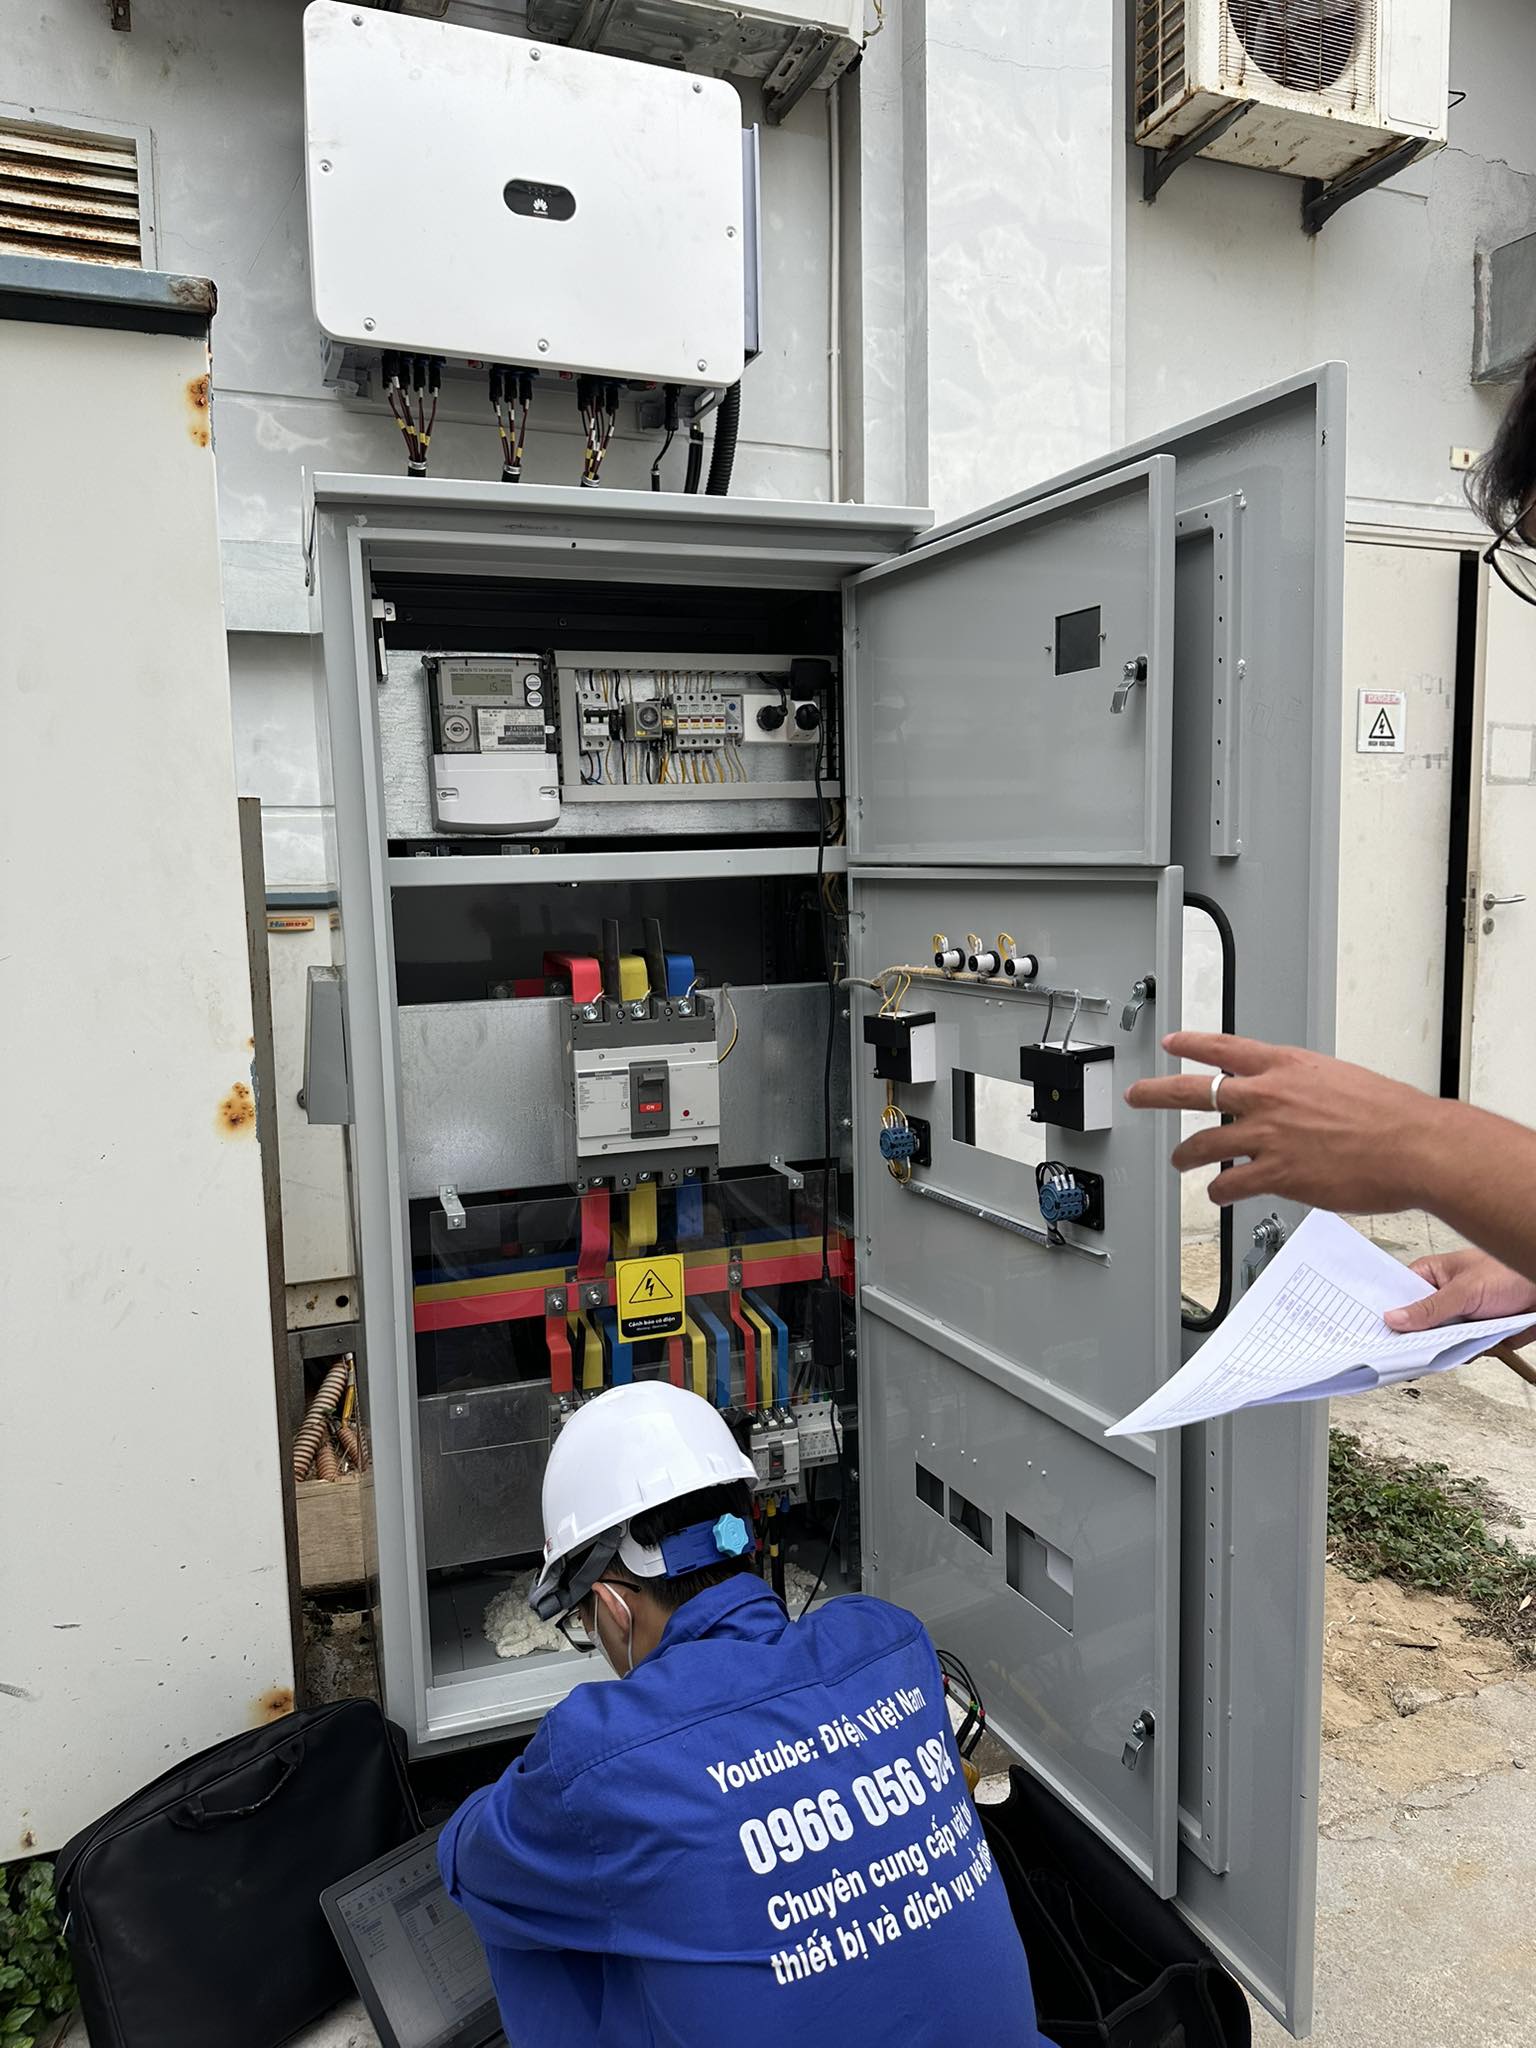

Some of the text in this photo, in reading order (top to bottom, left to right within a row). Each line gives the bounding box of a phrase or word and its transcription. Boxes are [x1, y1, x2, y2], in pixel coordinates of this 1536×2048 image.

[706, 1738, 820, 1794] Youtube:
[859, 1698, 903, 1735] Việt
[899, 1687, 926, 1715] Nam
[739, 1790, 854, 1875] 0966
[852, 1758, 927, 1827] 056
[768, 1869, 868, 1930] Chuyên
[869, 1843, 928, 1888] cung
[926, 1814, 956, 1859] cấp
[771, 1929, 838, 1985] thiết
[837, 1920, 869, 1961] bị
[868, 1905, 901, 1946] và
[904, 1882, 953, 1930] dịch
[951, 1871, 975, 1902] vụ
